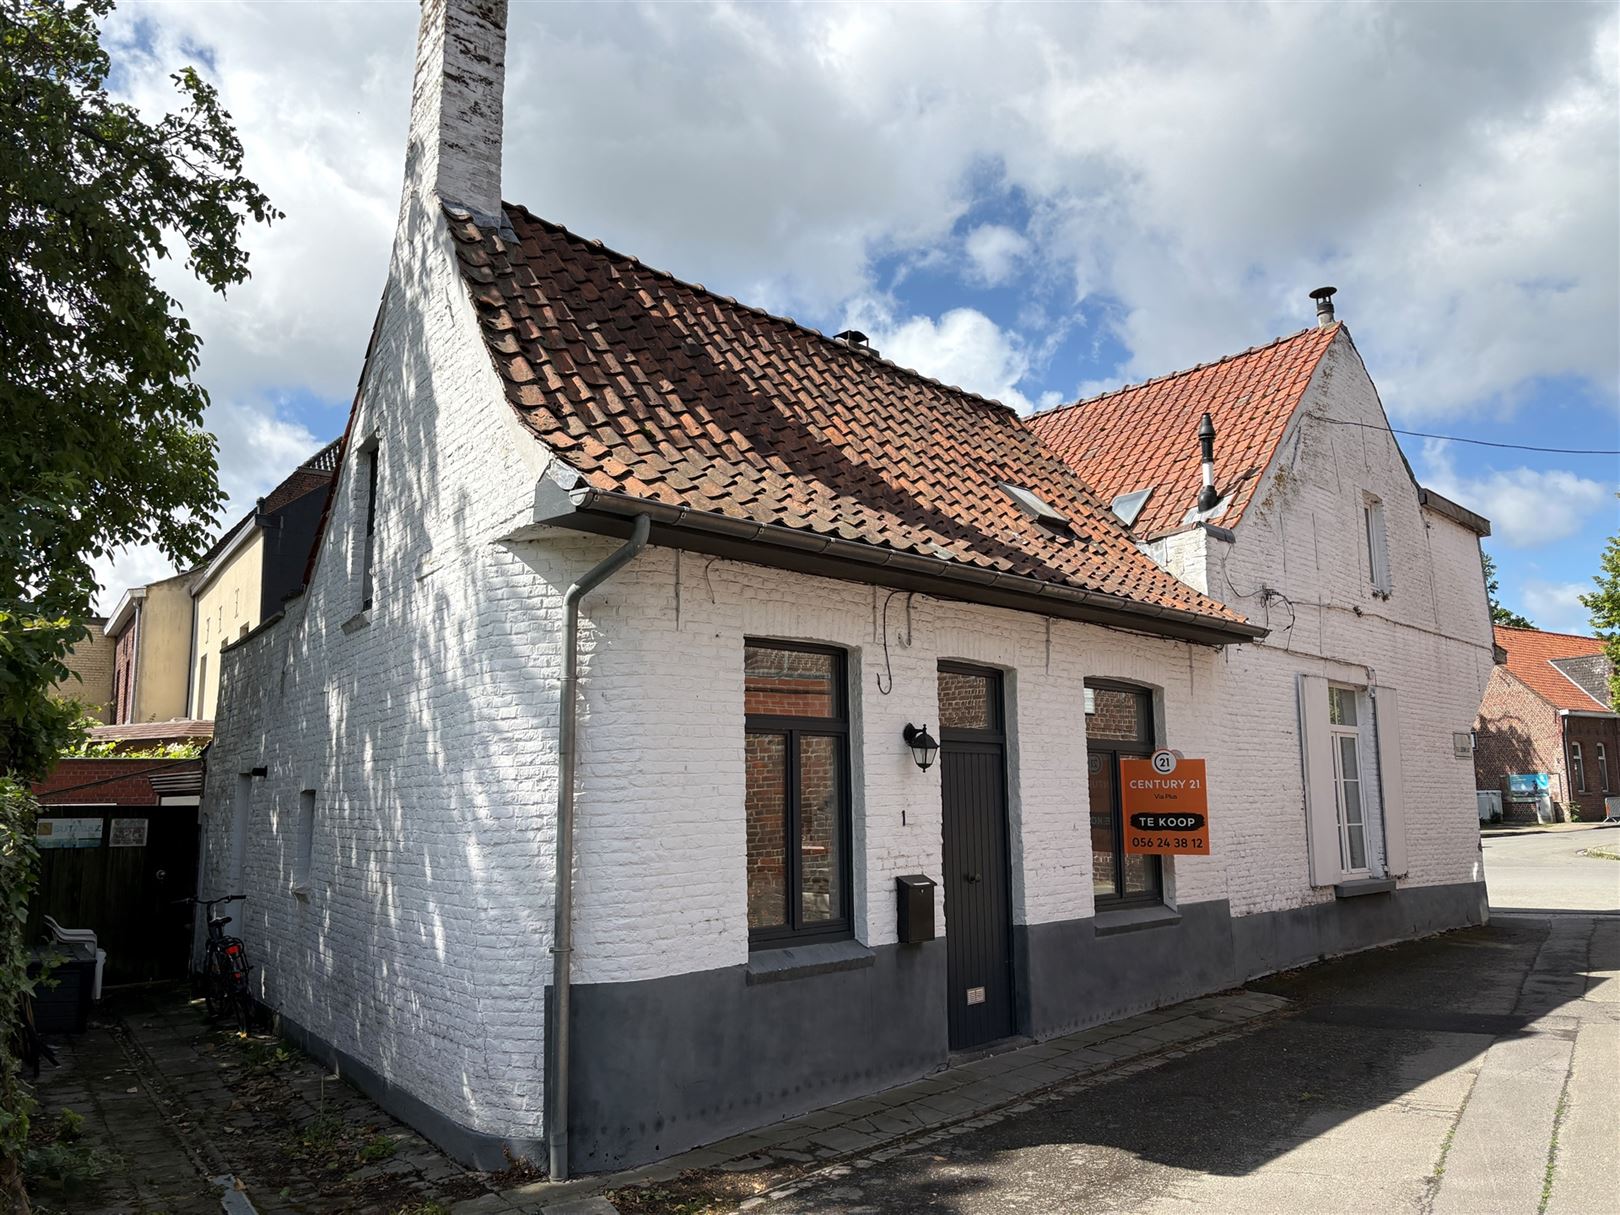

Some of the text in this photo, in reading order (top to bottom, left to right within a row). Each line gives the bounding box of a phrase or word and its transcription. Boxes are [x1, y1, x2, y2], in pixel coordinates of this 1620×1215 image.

[1129, 779, 1200, 789] CENTURY 21
[1139, 817, 1195, 827] TE KOOP
[1132, 837, 1203, 849] 056 24 38 12
